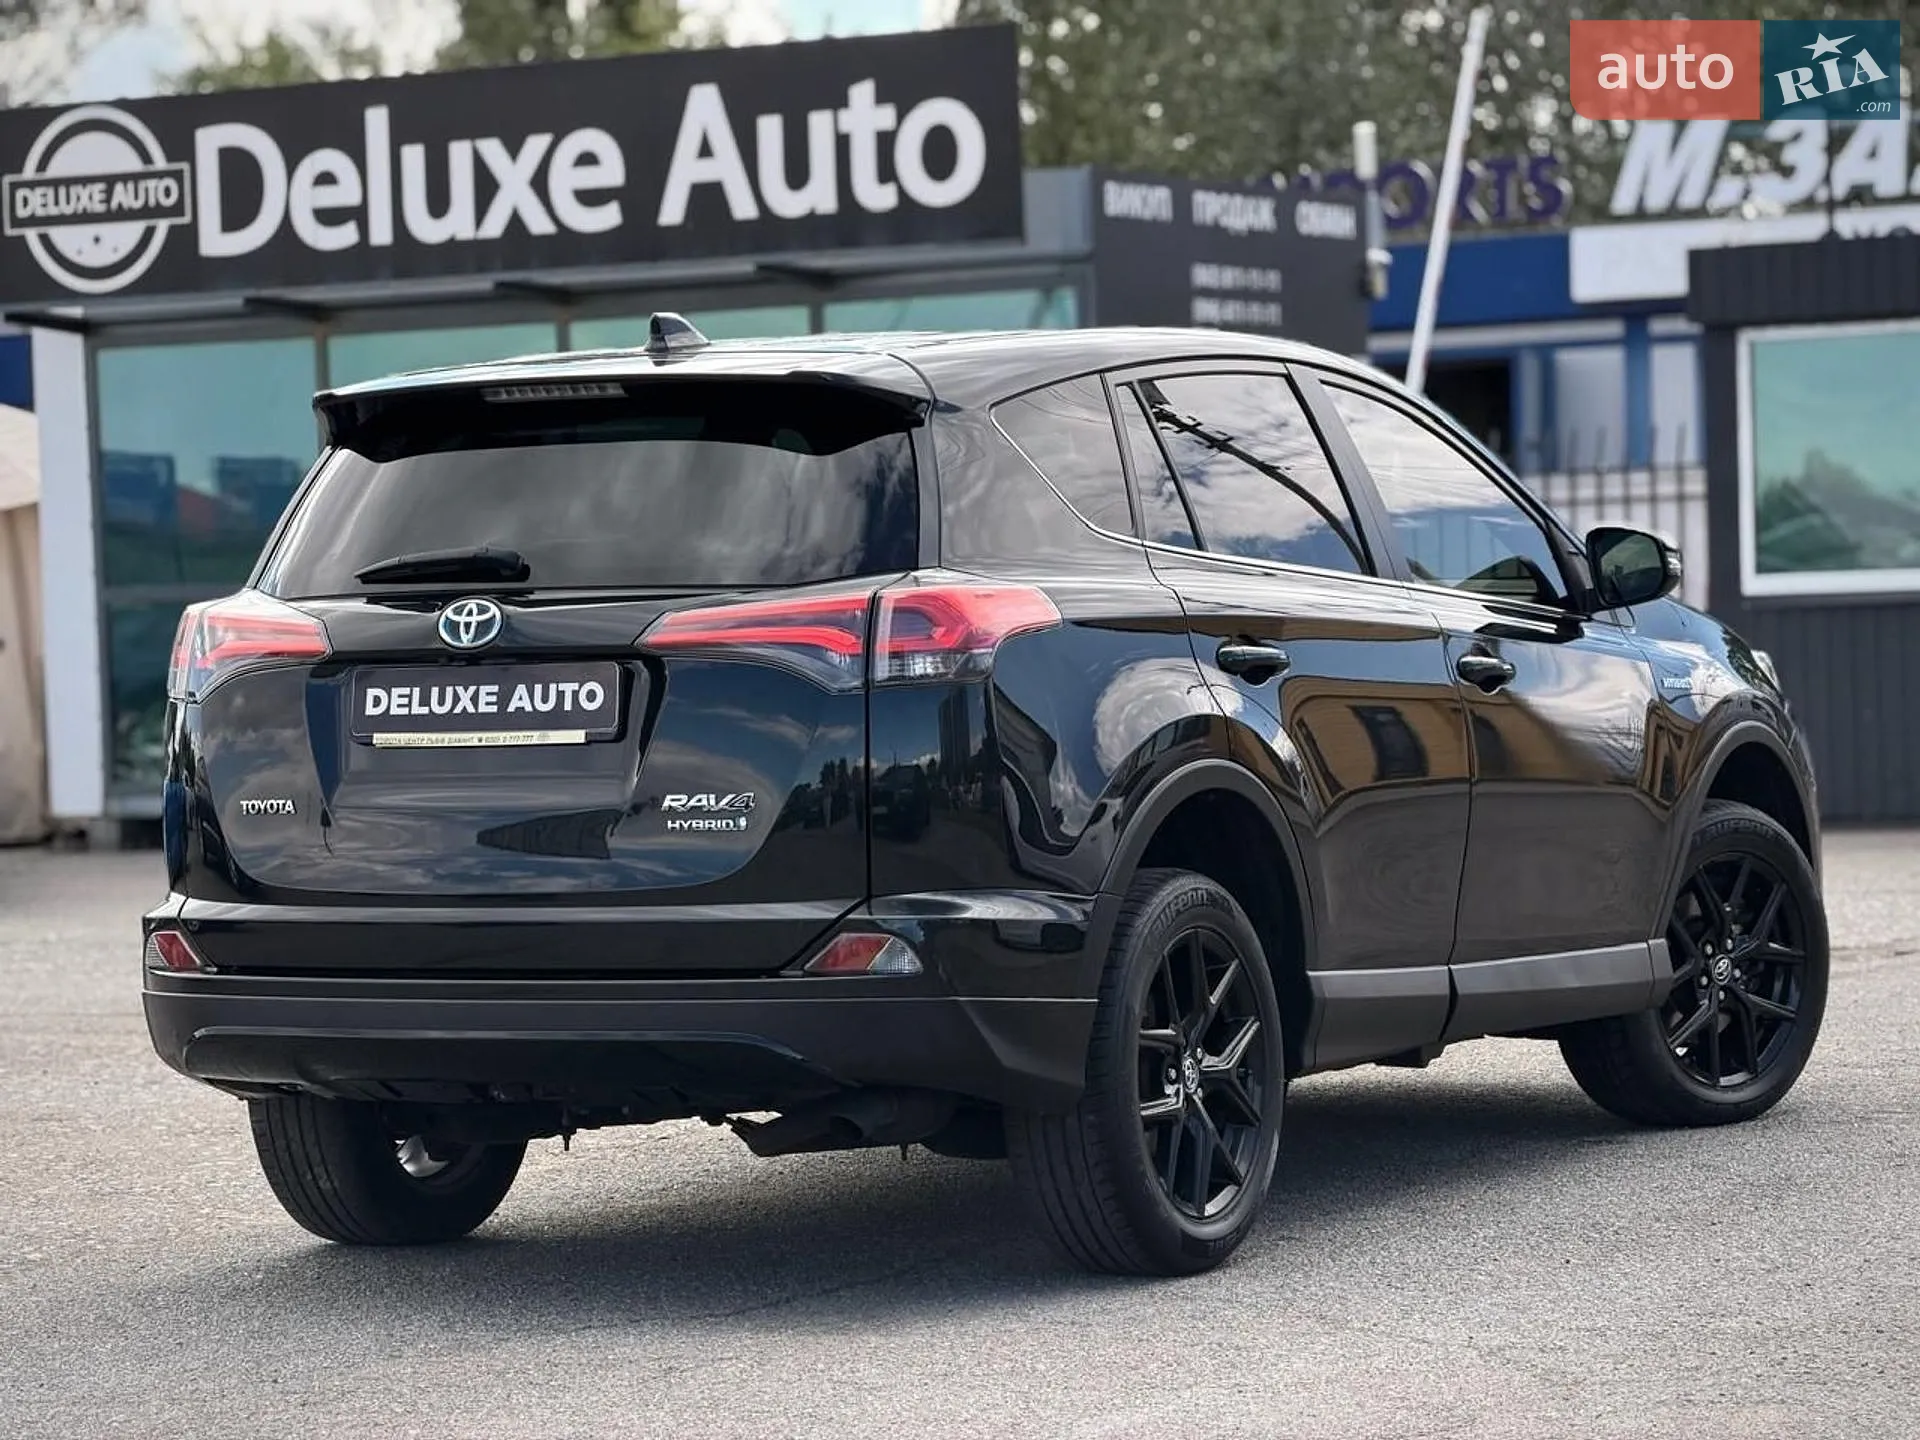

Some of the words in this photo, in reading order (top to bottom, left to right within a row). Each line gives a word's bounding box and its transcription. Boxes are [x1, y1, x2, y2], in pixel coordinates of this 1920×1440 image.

[194, 105, 627, 258] Deluxe
[656, 79, 987, 227] Auto
[15, 182, 108, 219] DELUXE
[110, 177, 180, 213] AUTO
[365, 685, 499, 716] DELUXE
[507, 681, 605, 713] AUTO
[240, 799, 297, 815] TOYOTA
[661, 792, 756, 813] RAV4
[667, 819, 735, 831] HYBRID
